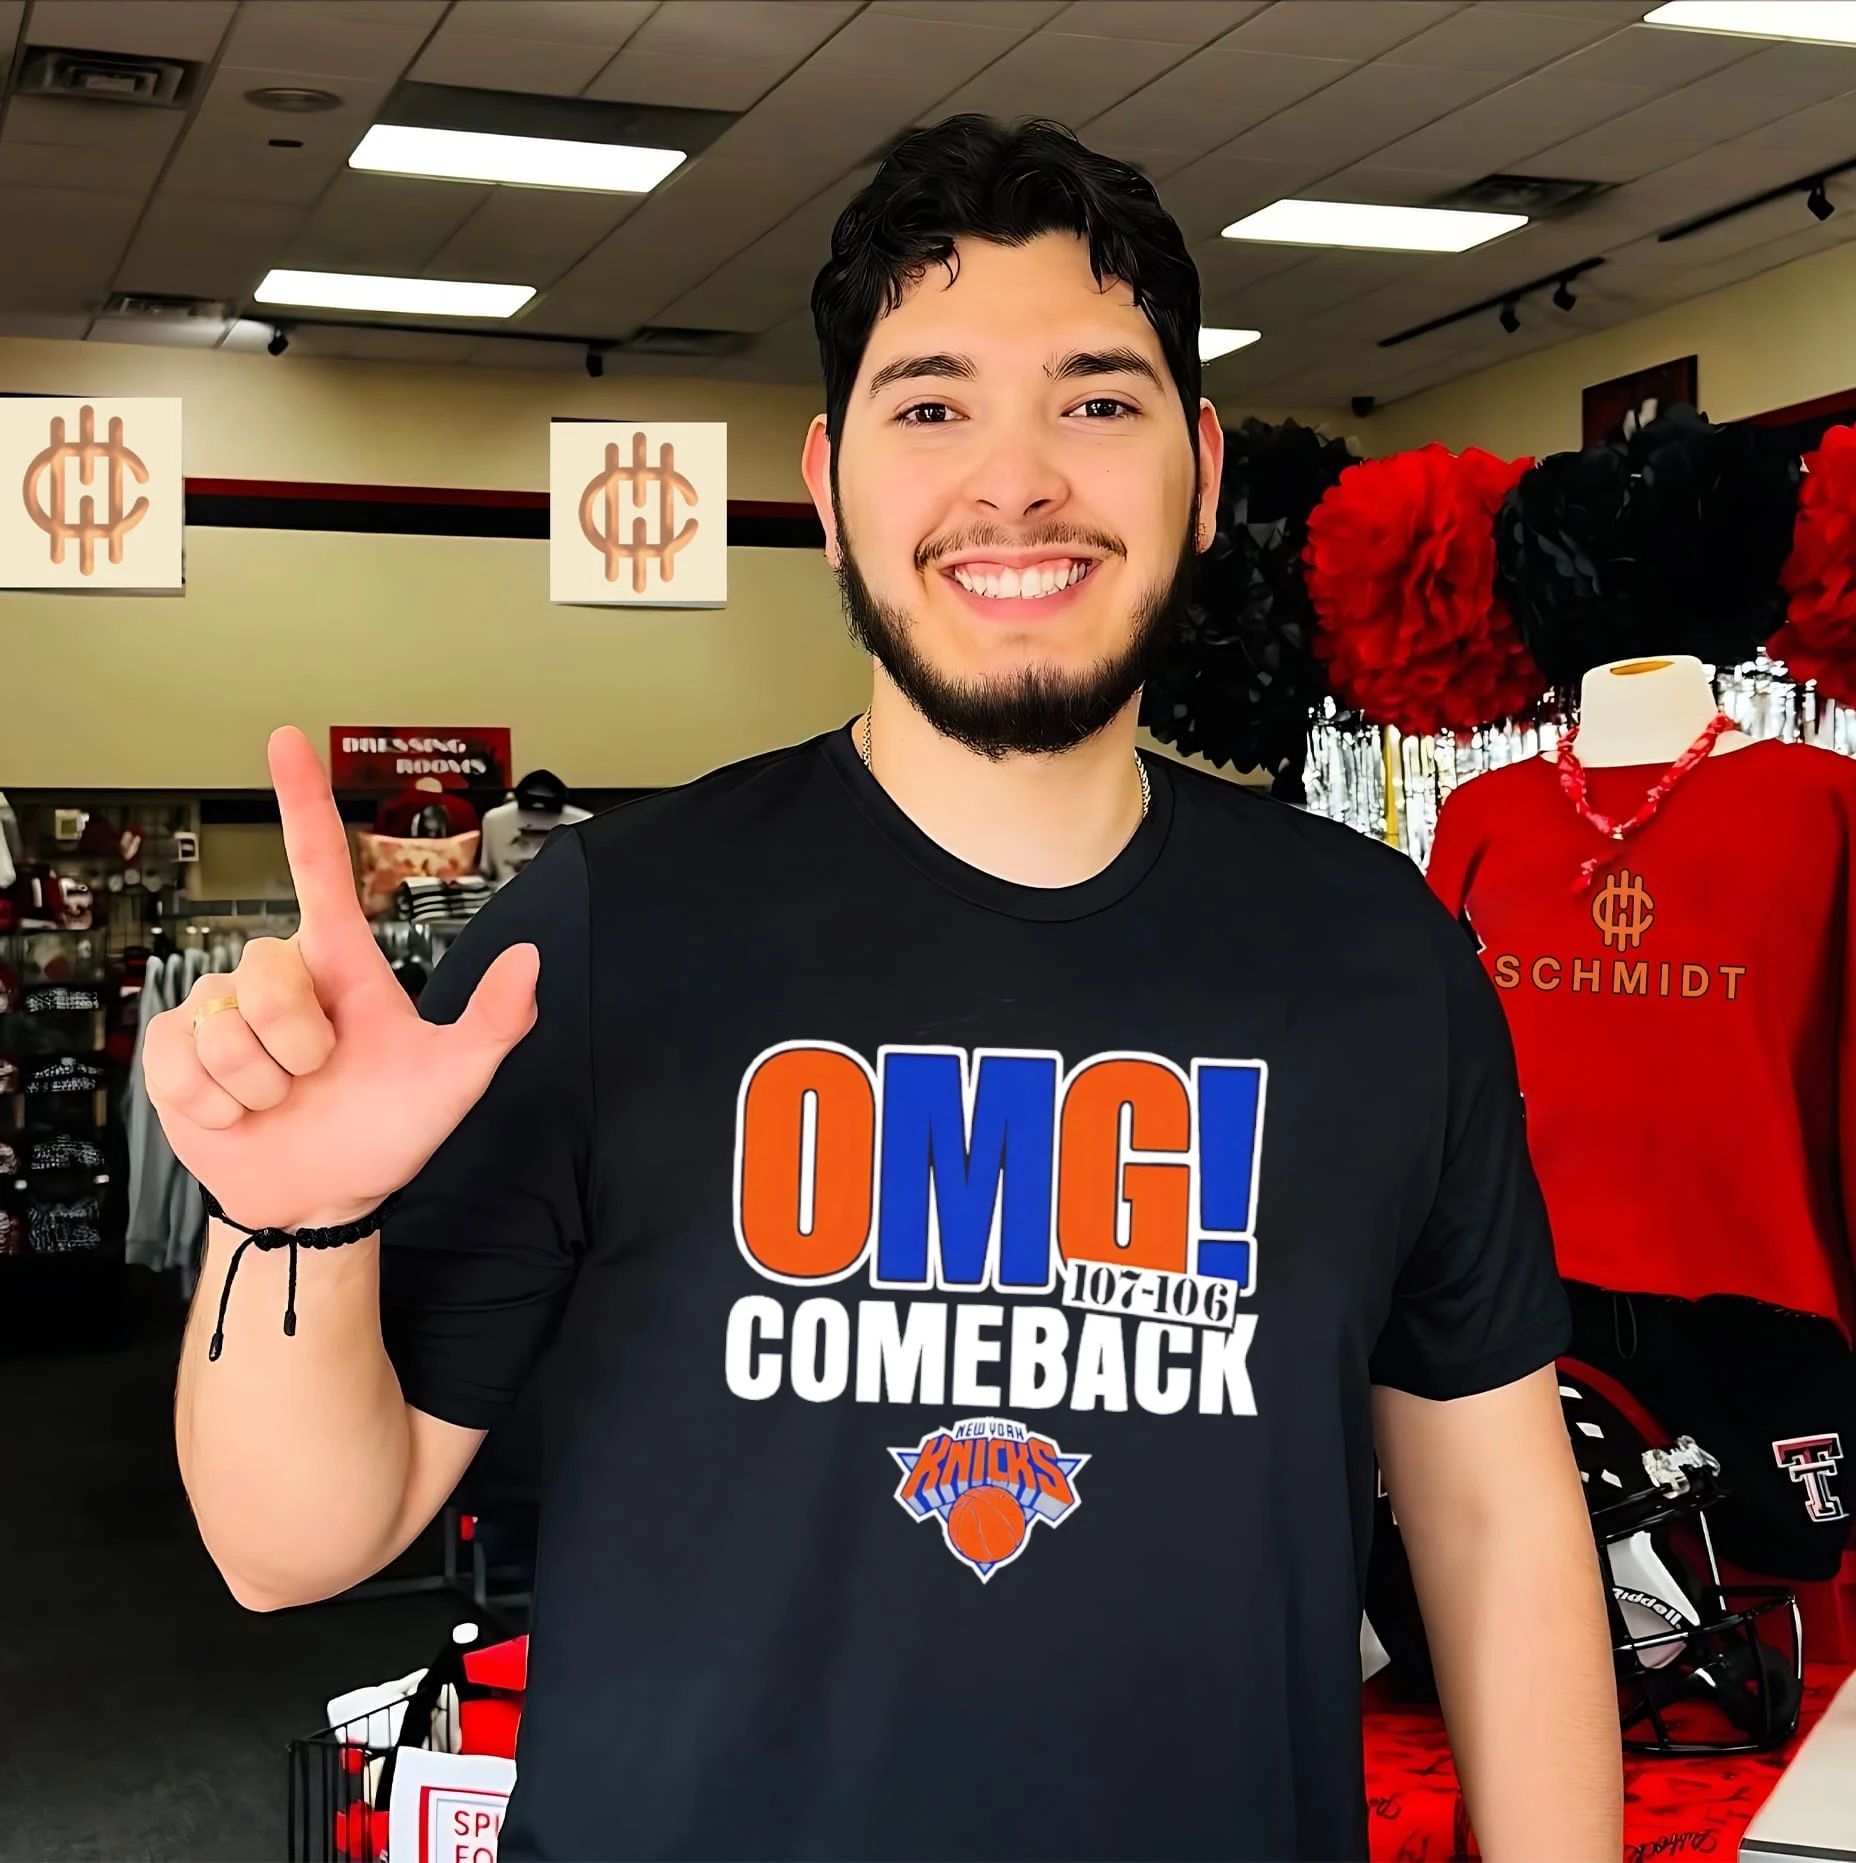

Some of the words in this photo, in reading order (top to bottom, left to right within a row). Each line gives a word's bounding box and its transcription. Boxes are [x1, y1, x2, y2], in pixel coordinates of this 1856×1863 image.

[396, 758, 487, 774] ROOMS
[1494, 953, 1747, 1000] SCHMIDT
[732, 1039, 1268, 1298] OMG!
[1071, 1264, 1229, 1322] 107-106
[725, 1294, 1260, 1416] COMEBACK
[955, 1422, 986, 1438] NEW
[989, 1422, 1025, 1440] YORK
[900, 1433, 1076, 1508] KNICKS
